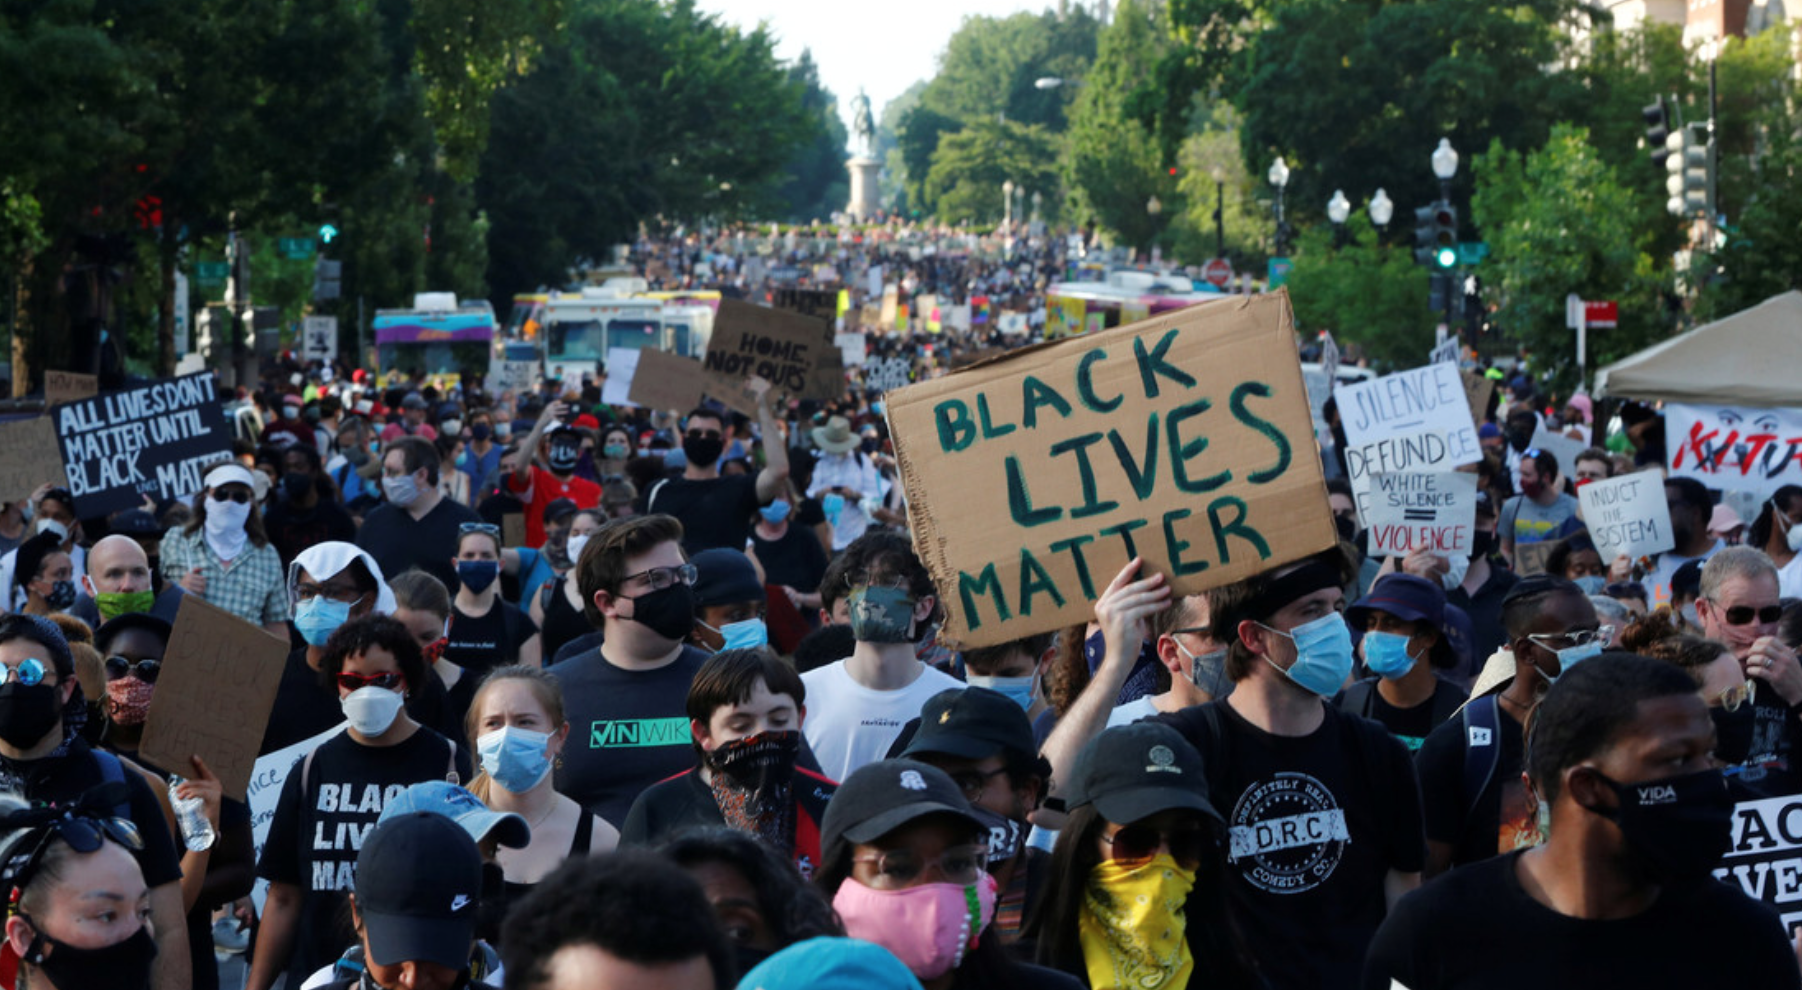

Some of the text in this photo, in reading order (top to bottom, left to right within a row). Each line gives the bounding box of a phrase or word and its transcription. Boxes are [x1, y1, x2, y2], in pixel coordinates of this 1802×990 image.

[705, 350, 755, 376] NOT
[60, 372, 215, 436] ALL LIVES DONT
[933, 328, 1197, 454] BLACK
[1355, 366, 1456, 432] SILENCE
[65, 409, 212, 463] MATTER UNTIL
[1004, 381, 1292, 528] LIVES
[66, 450, 146, 497] BLACK
[156, 450, 234, 499] MAT
[1347, 433, 1445, 479] DEFUND
[1379, 474, 1437, 492] WHITE
[1388, 492, 1456, 507] SILENCE
[1590, 479, 1641, 507] INDICT
[1602, 509, 1626, 523] THE
[1373, 524, 1467, 551] VIOLENCE
[957, 495, 1272, 632] MATTER
[1238, 779, 1299, 823] DEFINITELY
[1637, 785, 1676, 800] VIDA
[312, 860, 358, 891] MA
[1252, 866, 1305, 887] COMEDY
